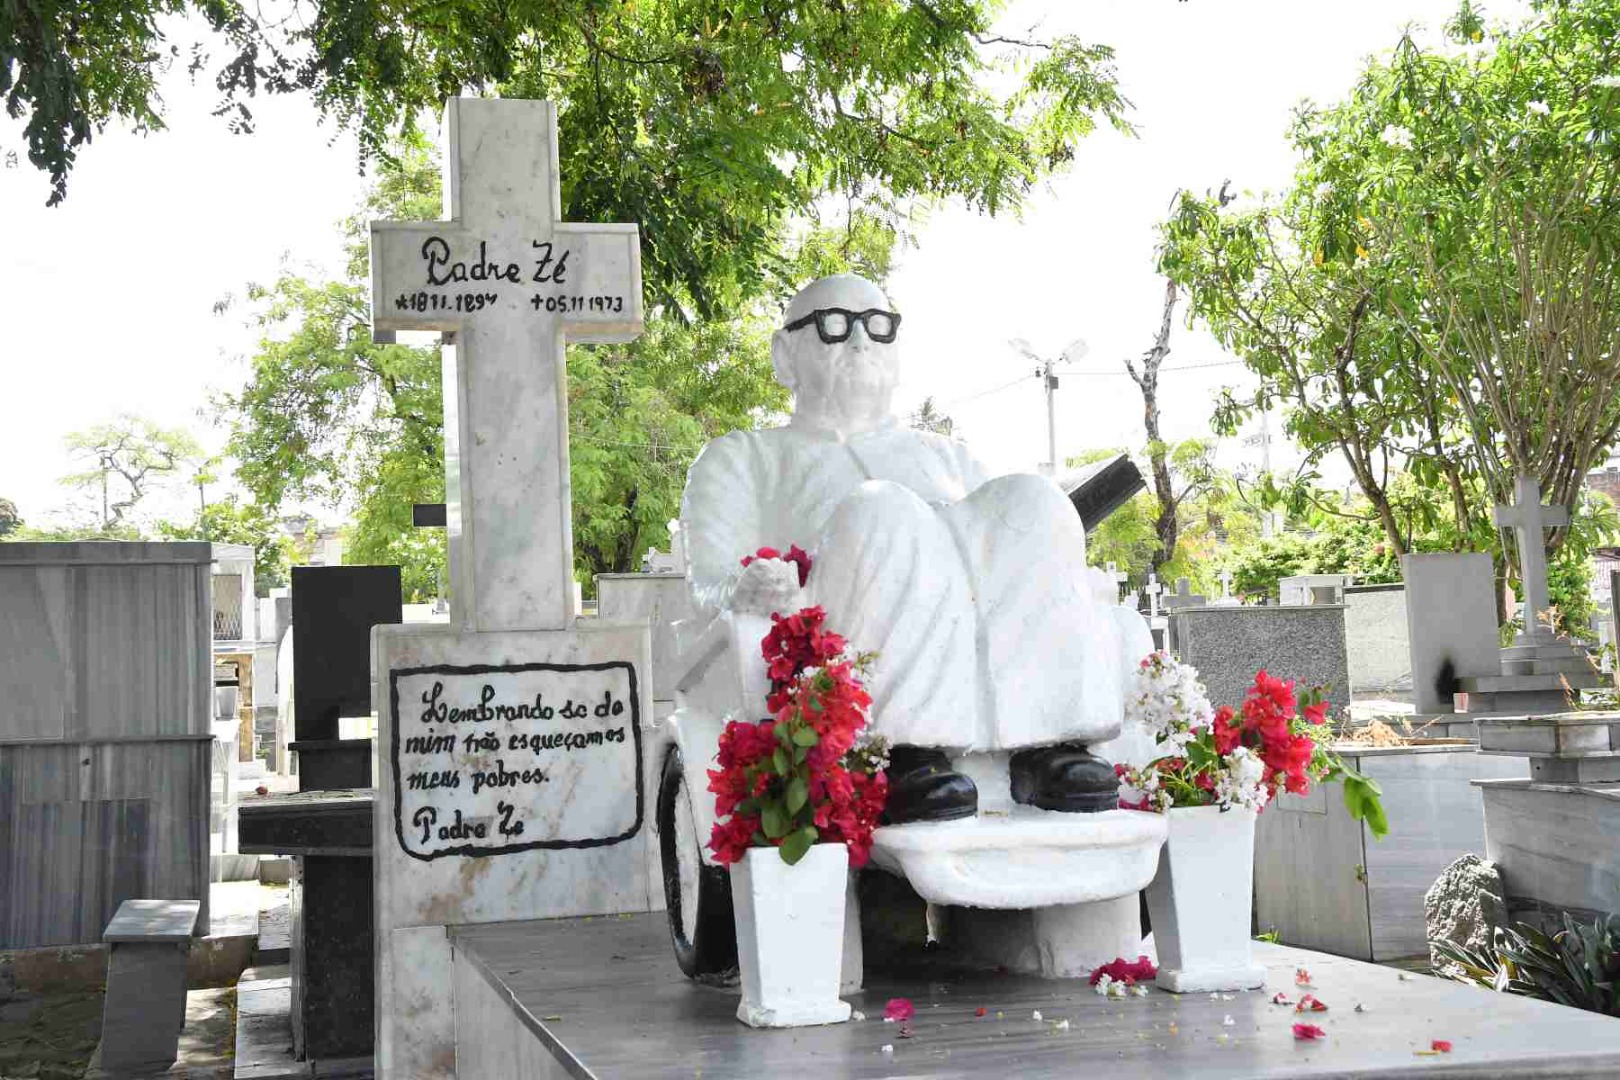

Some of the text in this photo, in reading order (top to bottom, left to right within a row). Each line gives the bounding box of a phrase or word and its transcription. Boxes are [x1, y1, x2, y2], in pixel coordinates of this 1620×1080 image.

[421, 236, 521, 286] Padre
[420, 681, 554, 724] Lembrando
[462, 731, 501, 754] não
[406, 770, 461, 791] meus
